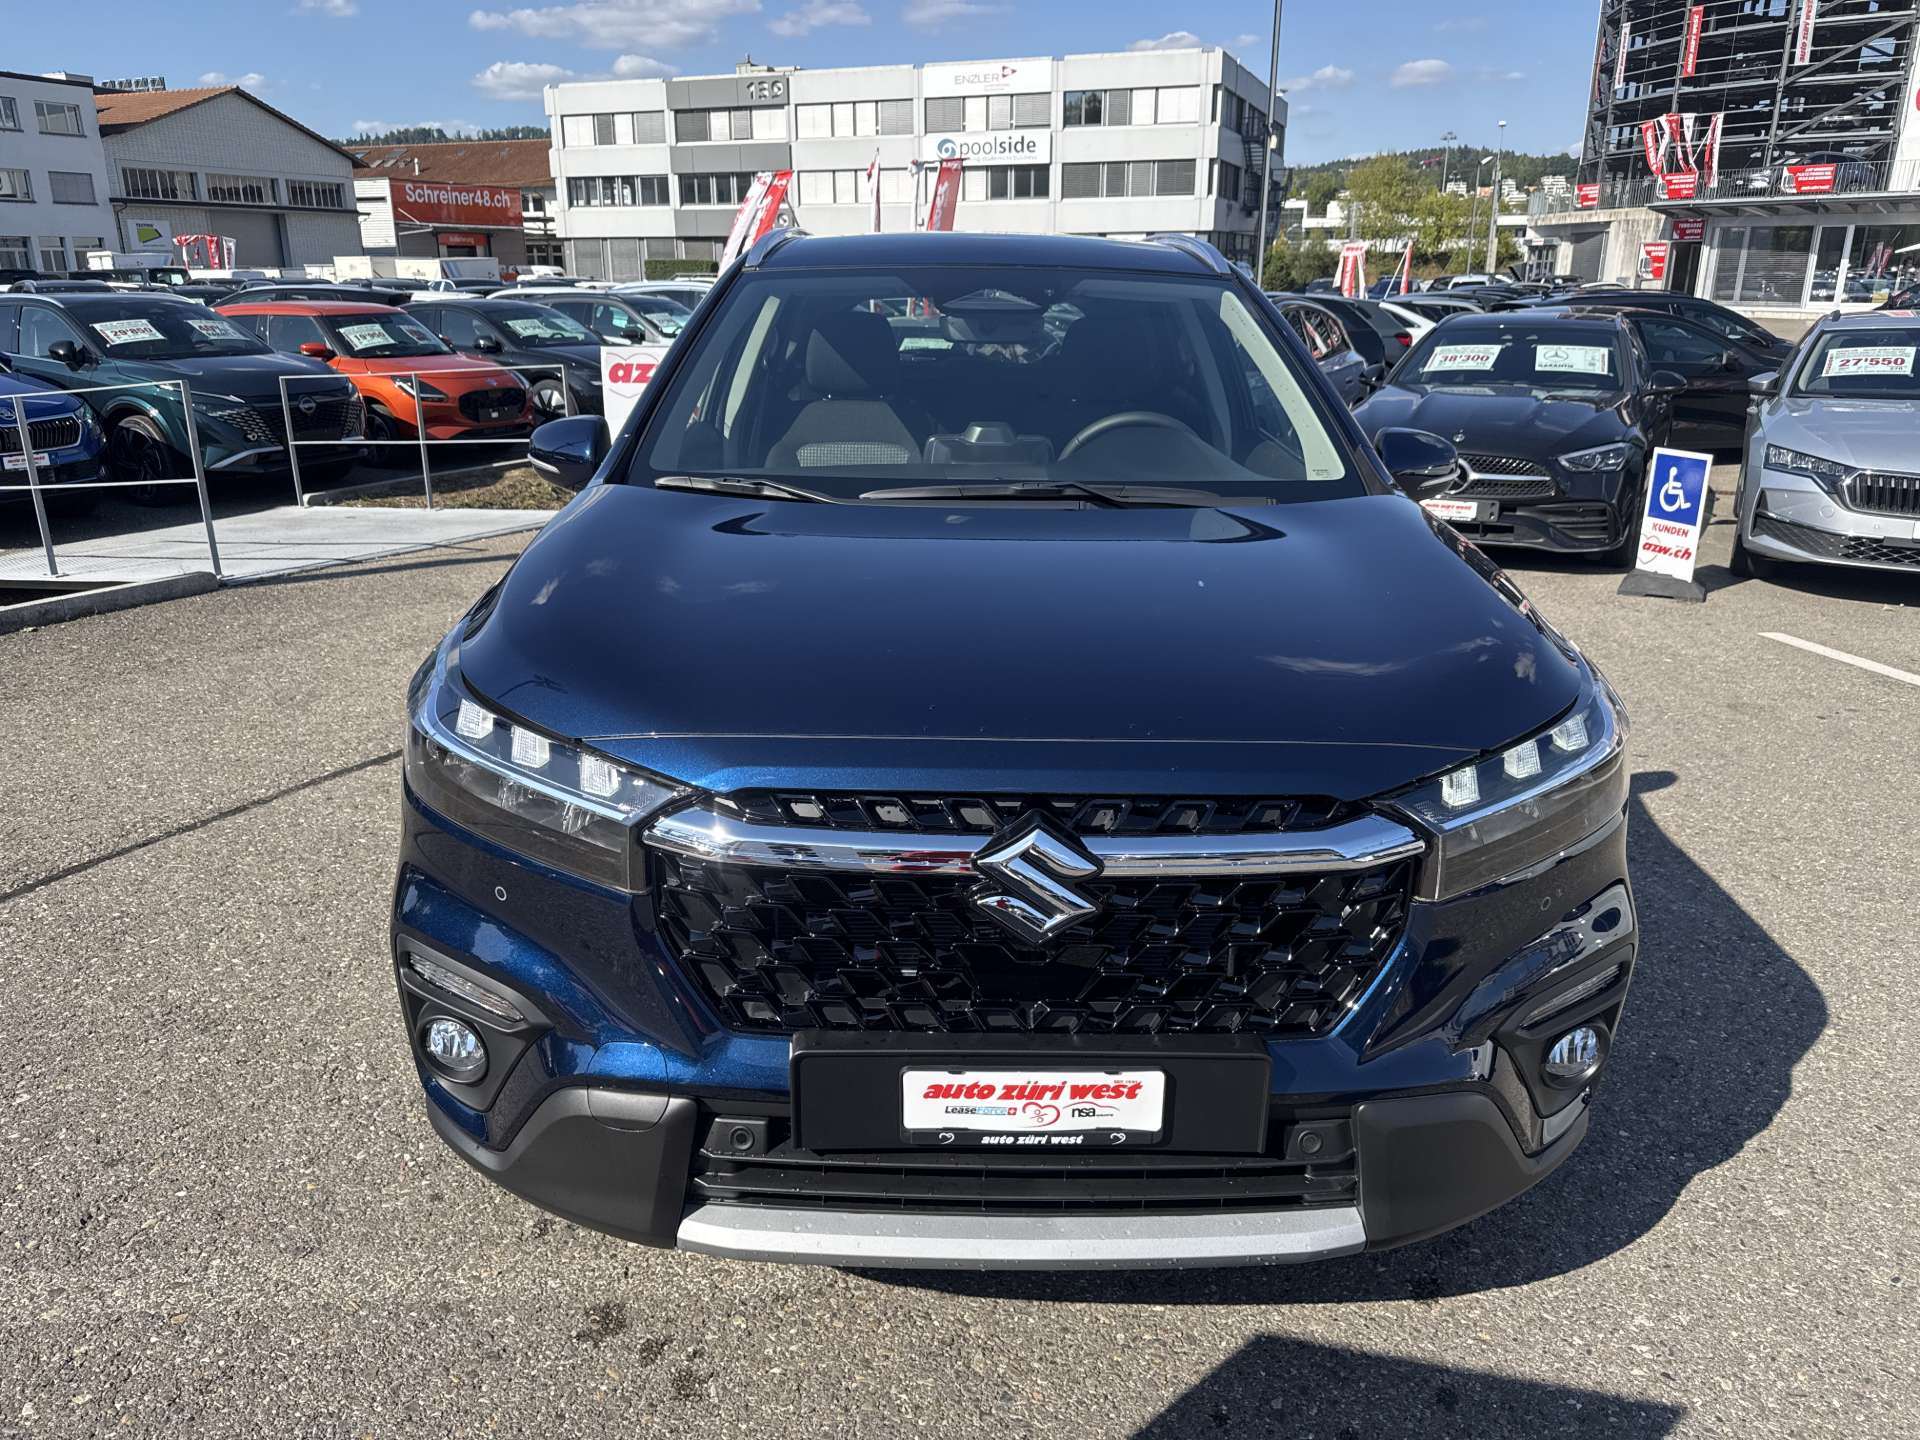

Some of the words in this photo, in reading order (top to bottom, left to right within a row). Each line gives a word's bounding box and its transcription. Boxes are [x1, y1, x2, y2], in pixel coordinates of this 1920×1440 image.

[954, 73, 1000, 85] ENZLER
[960, 135, 1037, 156] poolside
[405, 183, 511, 208] Schreiner48.ch
[1440, 354, 1490, 362] 38'300
[1839, 357, 1906, 368] 27'550
[1652, 522, 1689, 538] KUNDEN
[1642, 541, 1692, 561] azw.ch
[923, 1081, 996, 1099] auto
[997, 1080, 1067, 1100] züri
[1069, 1081, 1143, 1099] west
[1072, 1107, 1096, 1118] nsa
[981, 1135, 1015, 1144] auto
[1016, 1134, 1048, 1144] züri
[1051, 1135, 1084, 1144] west
